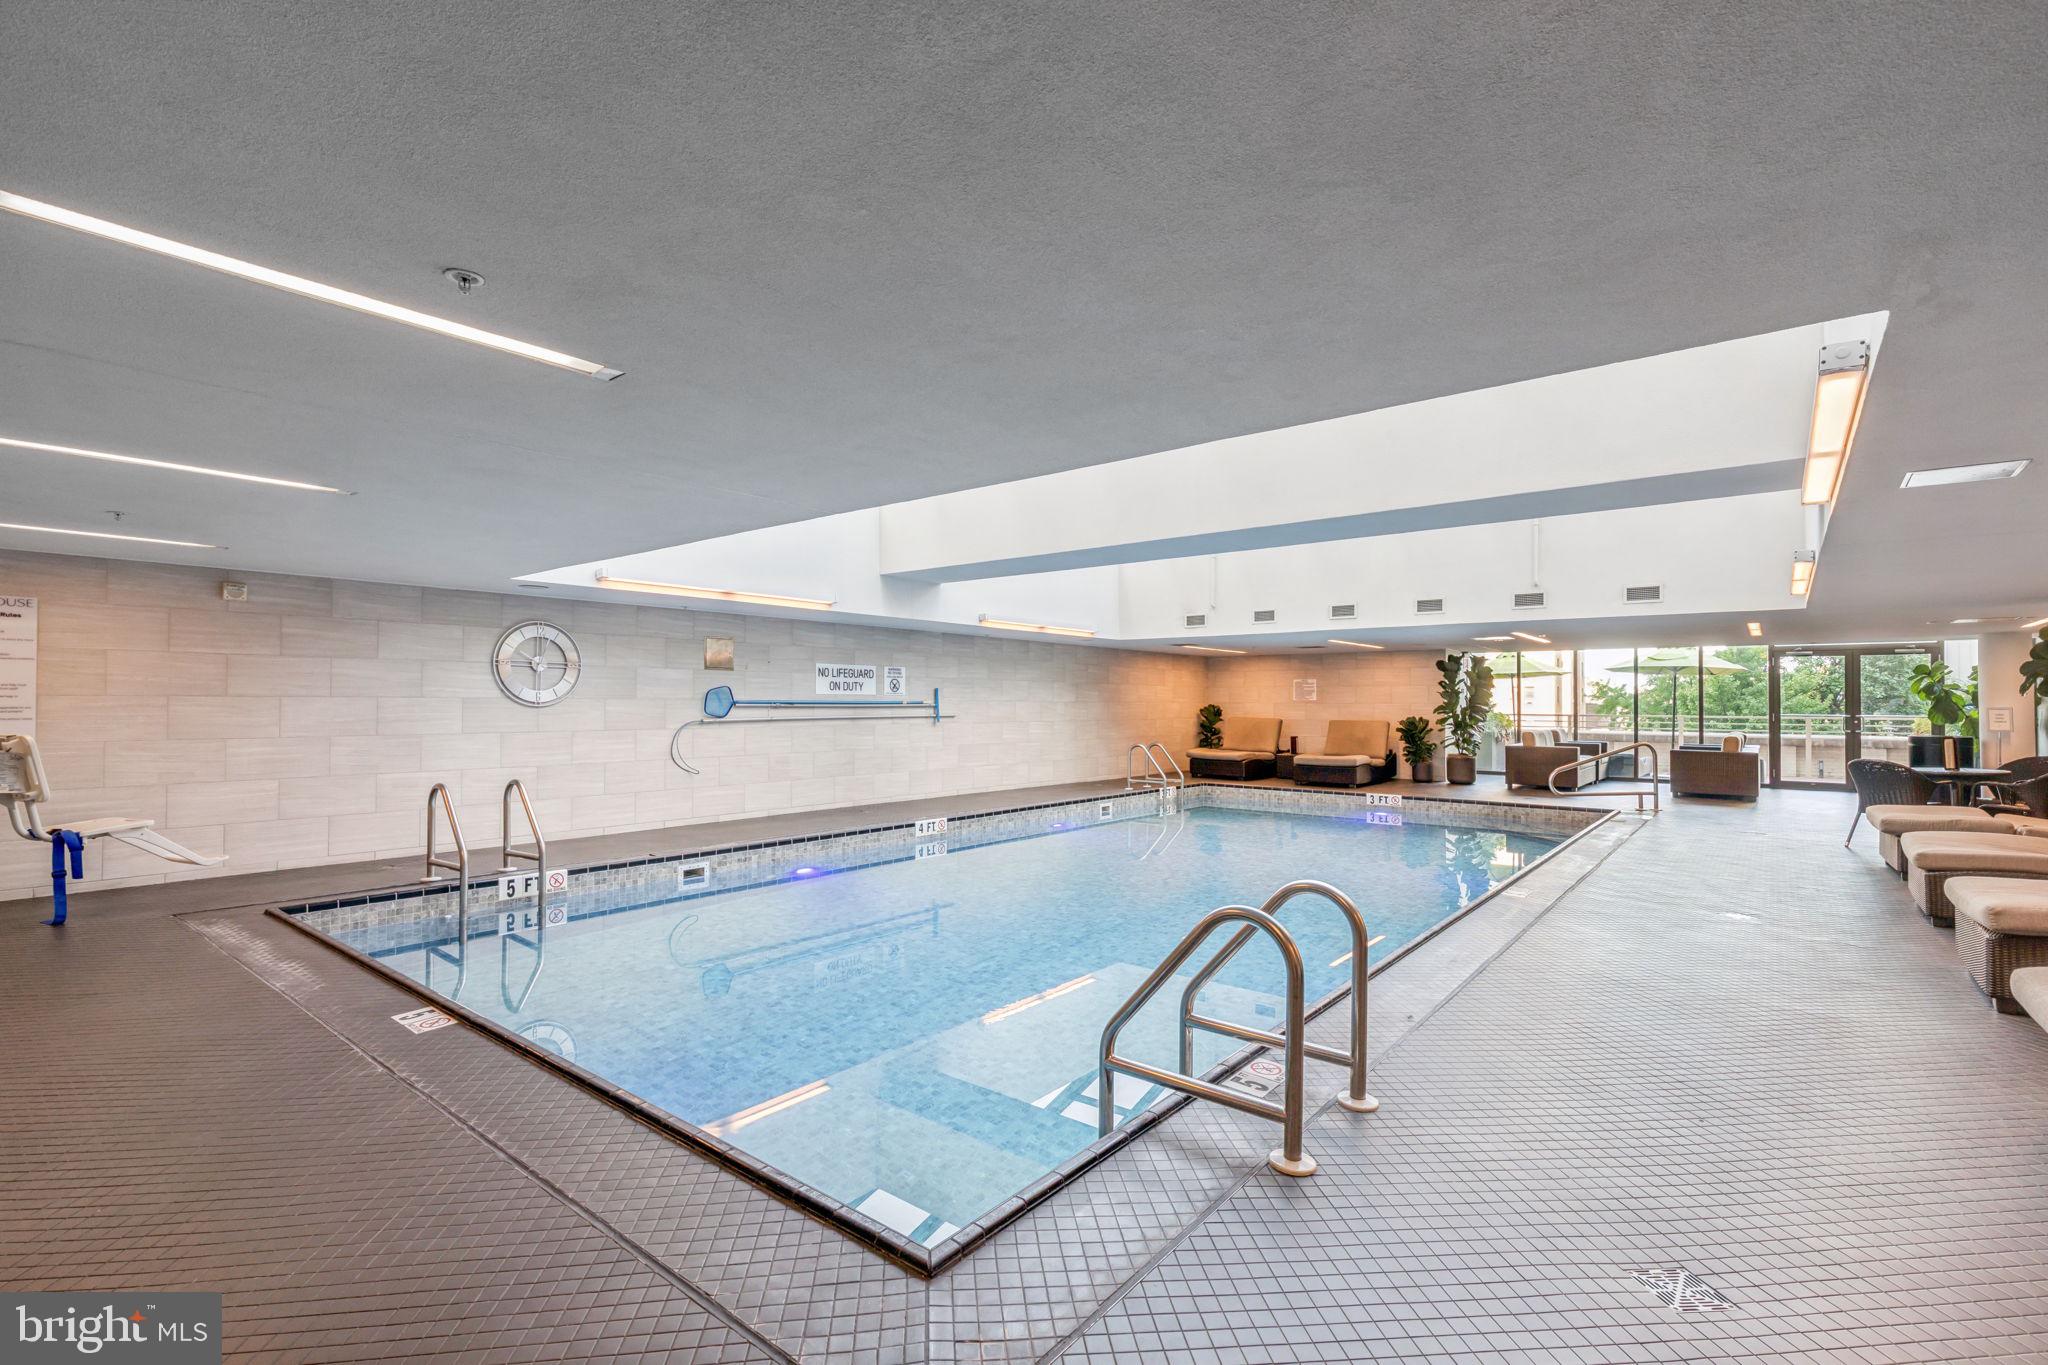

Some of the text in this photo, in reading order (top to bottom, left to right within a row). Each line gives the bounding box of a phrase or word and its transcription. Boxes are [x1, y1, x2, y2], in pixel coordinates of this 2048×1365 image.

[818, 667, 875, 679] NO LIFEGUARD
[829, 681, 864, 692] ON DUTY
[1370, 795, 1389, 804] 3 FT
[919, 821, 936, 833] 4 FT
[507, 879, 516, 897] 5
